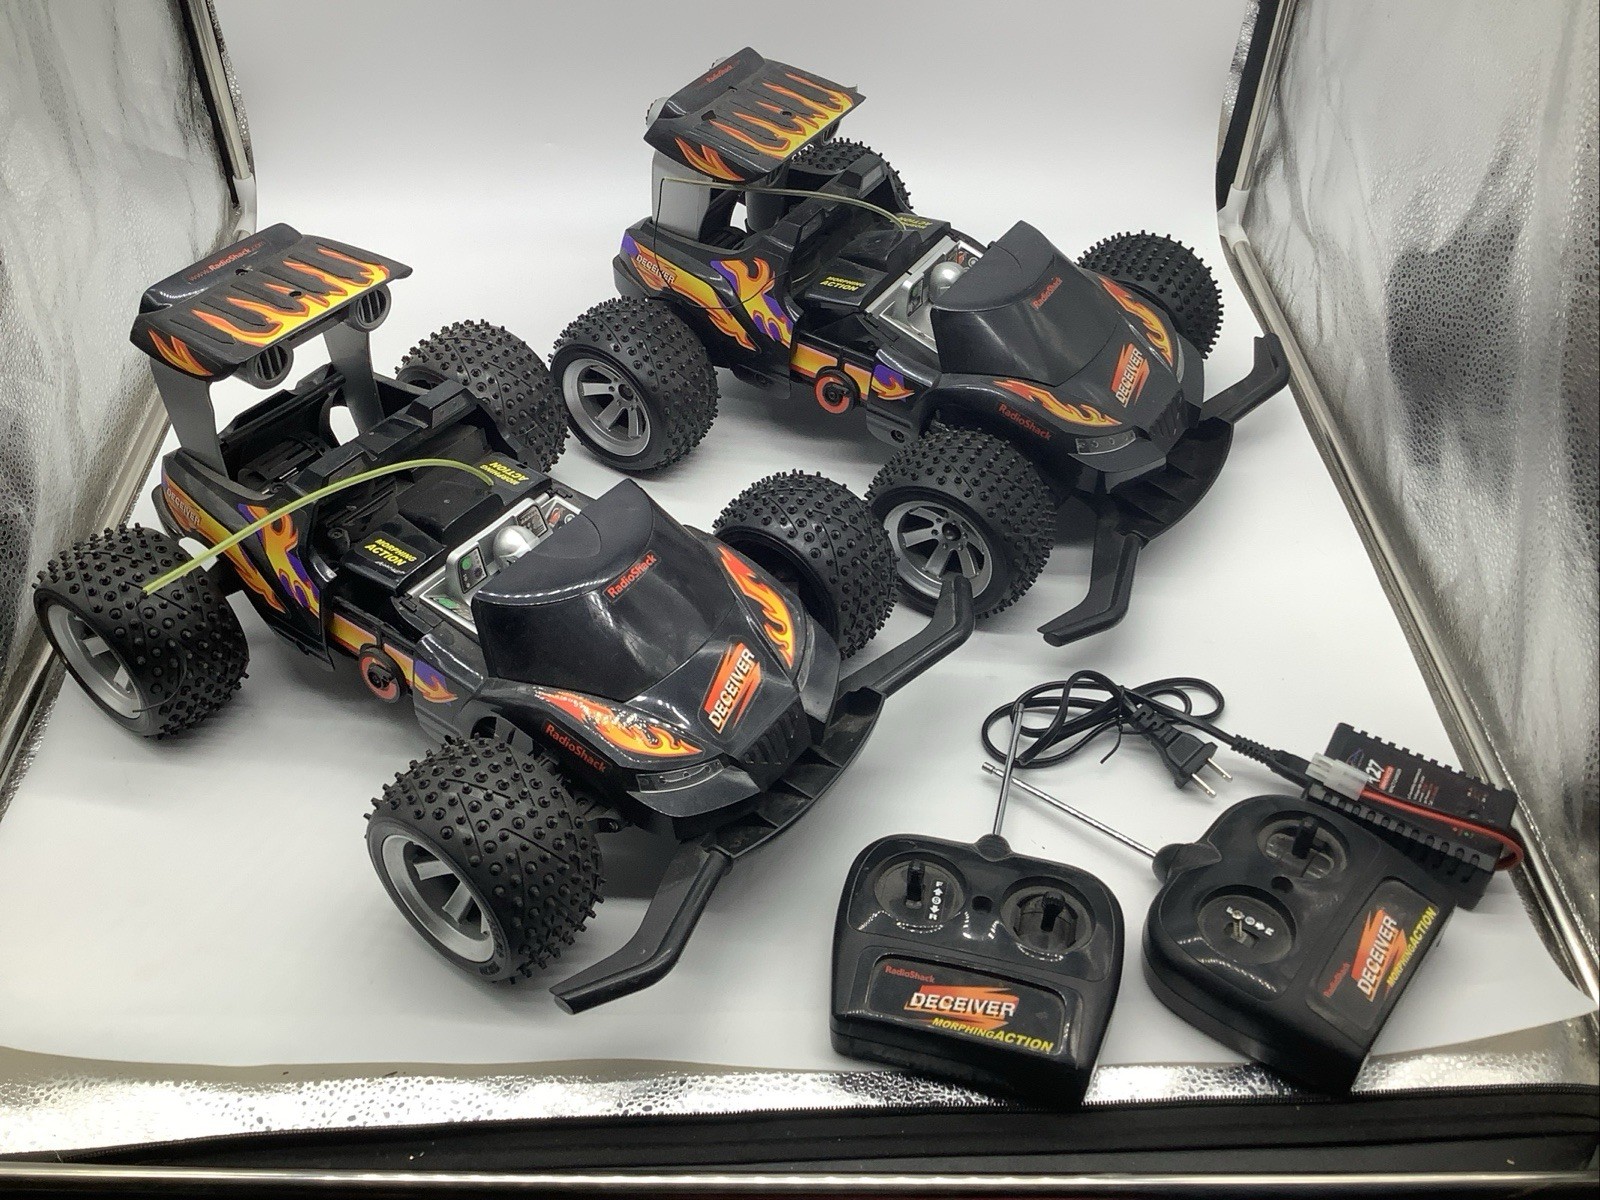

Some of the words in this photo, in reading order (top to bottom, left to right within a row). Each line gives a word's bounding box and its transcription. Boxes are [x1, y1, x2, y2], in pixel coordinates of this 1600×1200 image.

[820, 280, 859, 291] ACTION
[1031, 276, 1063, 310] RadioShack
[1115, 347, 1143, 405] DECEIVER
[999, 403, 1052, 440] RadioShack
[480, 464, 520, 485] MORPHING
[489, 461, 529, 481] ACTION
[166, 487, 200, 526] DECEIVER
[364, 544, 407, 567] ACTION
[374, 538, 417, 562] MORPHING
[607, 554, 657, 598] RadioShack
[708, 648, 755, 729] DECEIVER
[546, 723, 606, 773] RadioShack
[1357, 915, 1398, 996] DECEIVER
[885, 965, 935, 983] RadioShack
[910, 992, 1016, 1017] DECEIVER
[927, 1017, 1054, 1055] MORPHINGACTION
